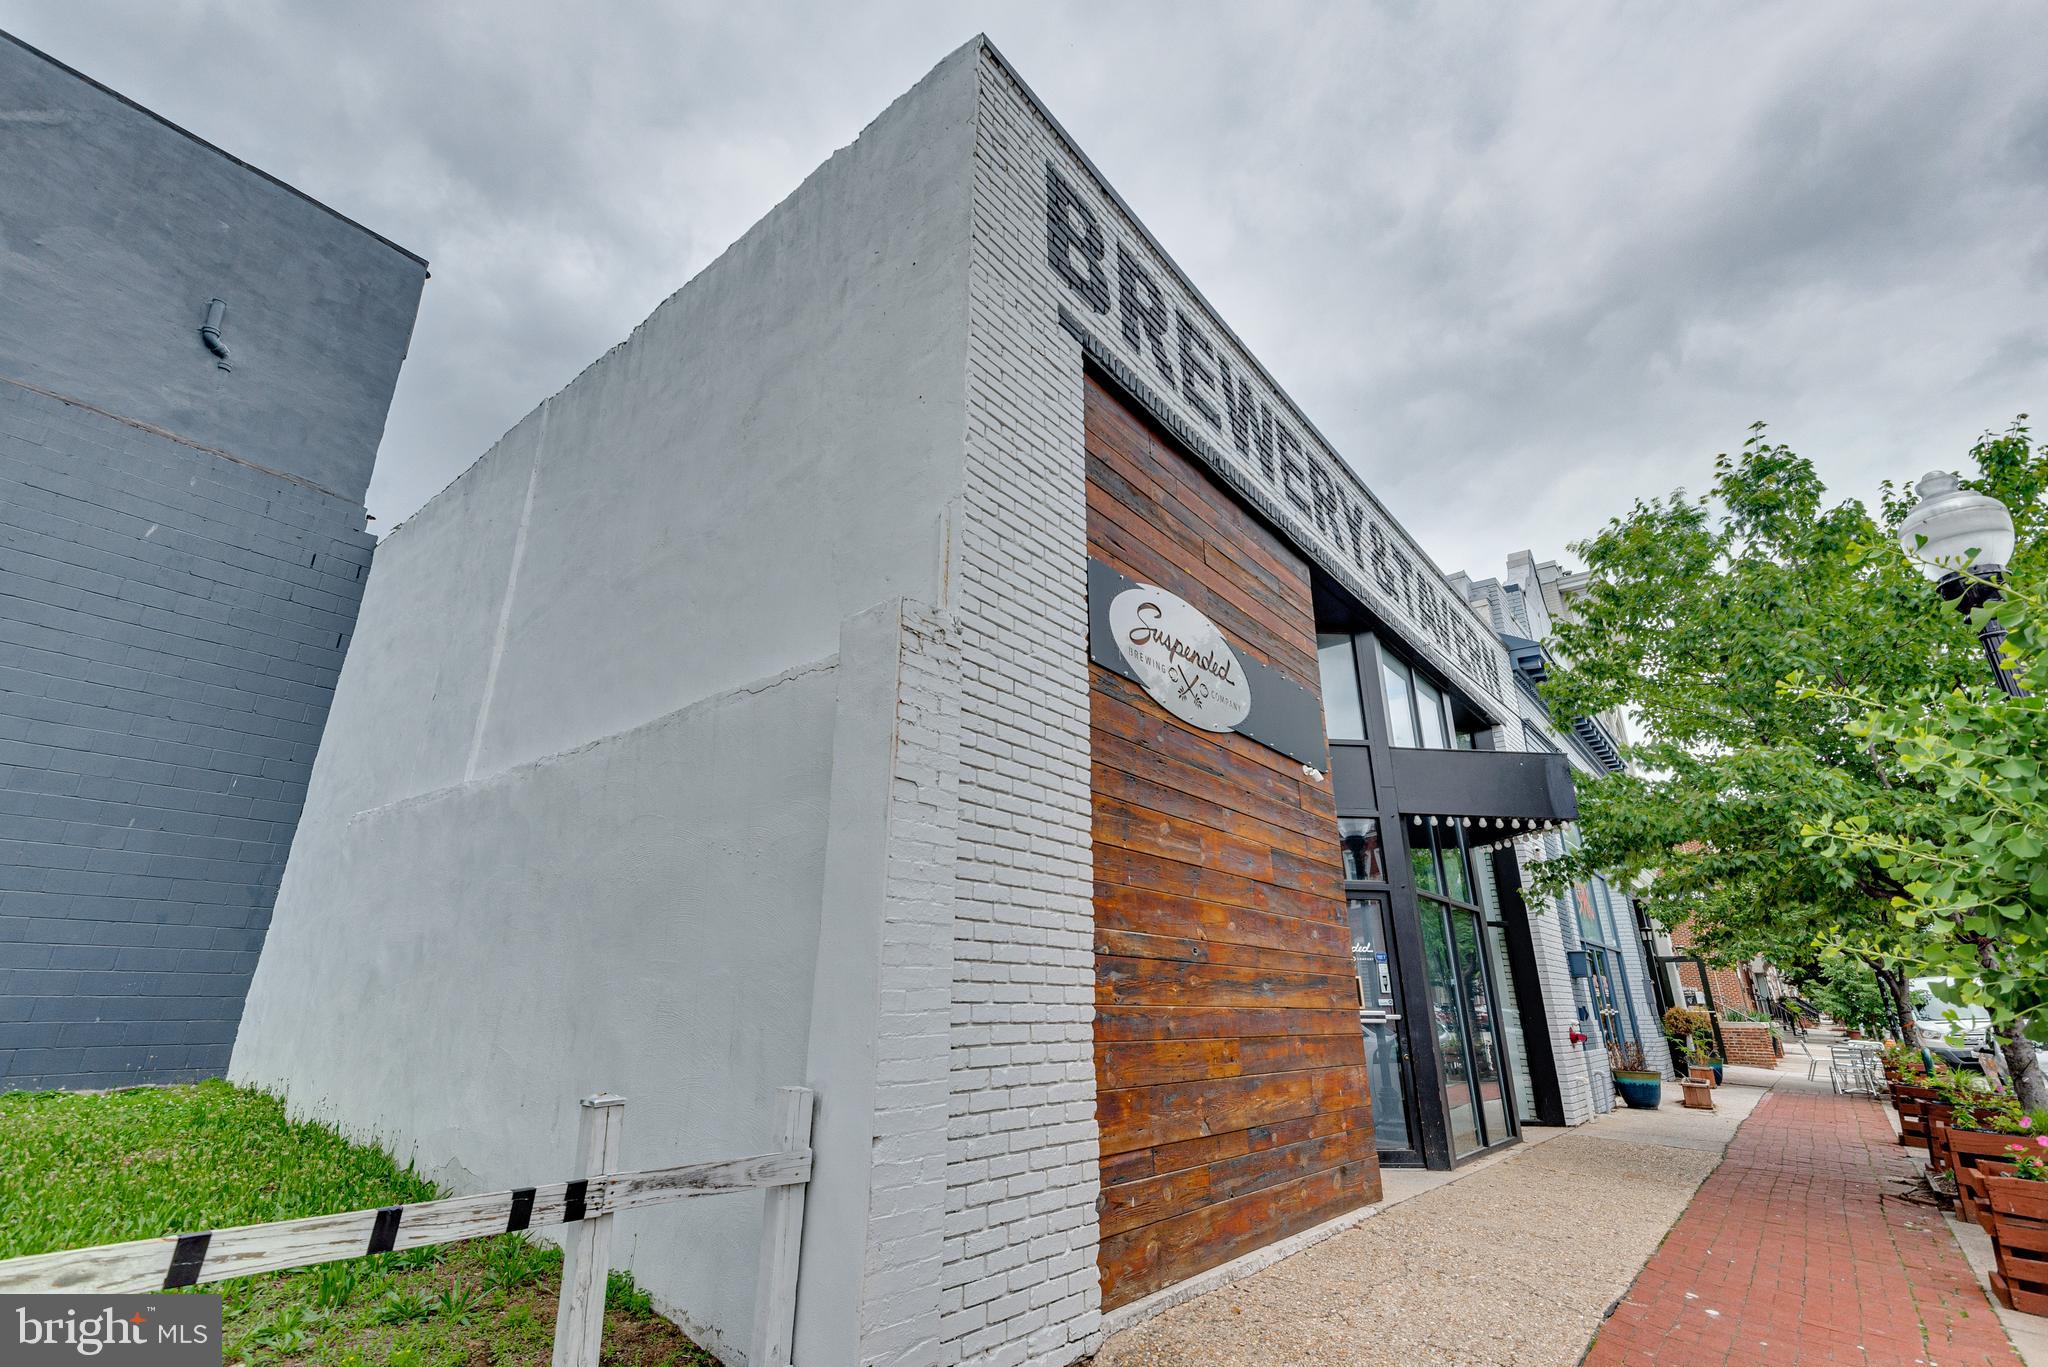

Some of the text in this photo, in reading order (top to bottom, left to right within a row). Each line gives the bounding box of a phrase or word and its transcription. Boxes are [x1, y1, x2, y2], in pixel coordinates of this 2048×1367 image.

[1046, 160, 1364, 570] BREWERY
[1391, 540, 1503, 703] TAVERN
[1128, 647, 1241, 712] BREWING COMPANY
[1129, 602, 1235, 686] Suspended
